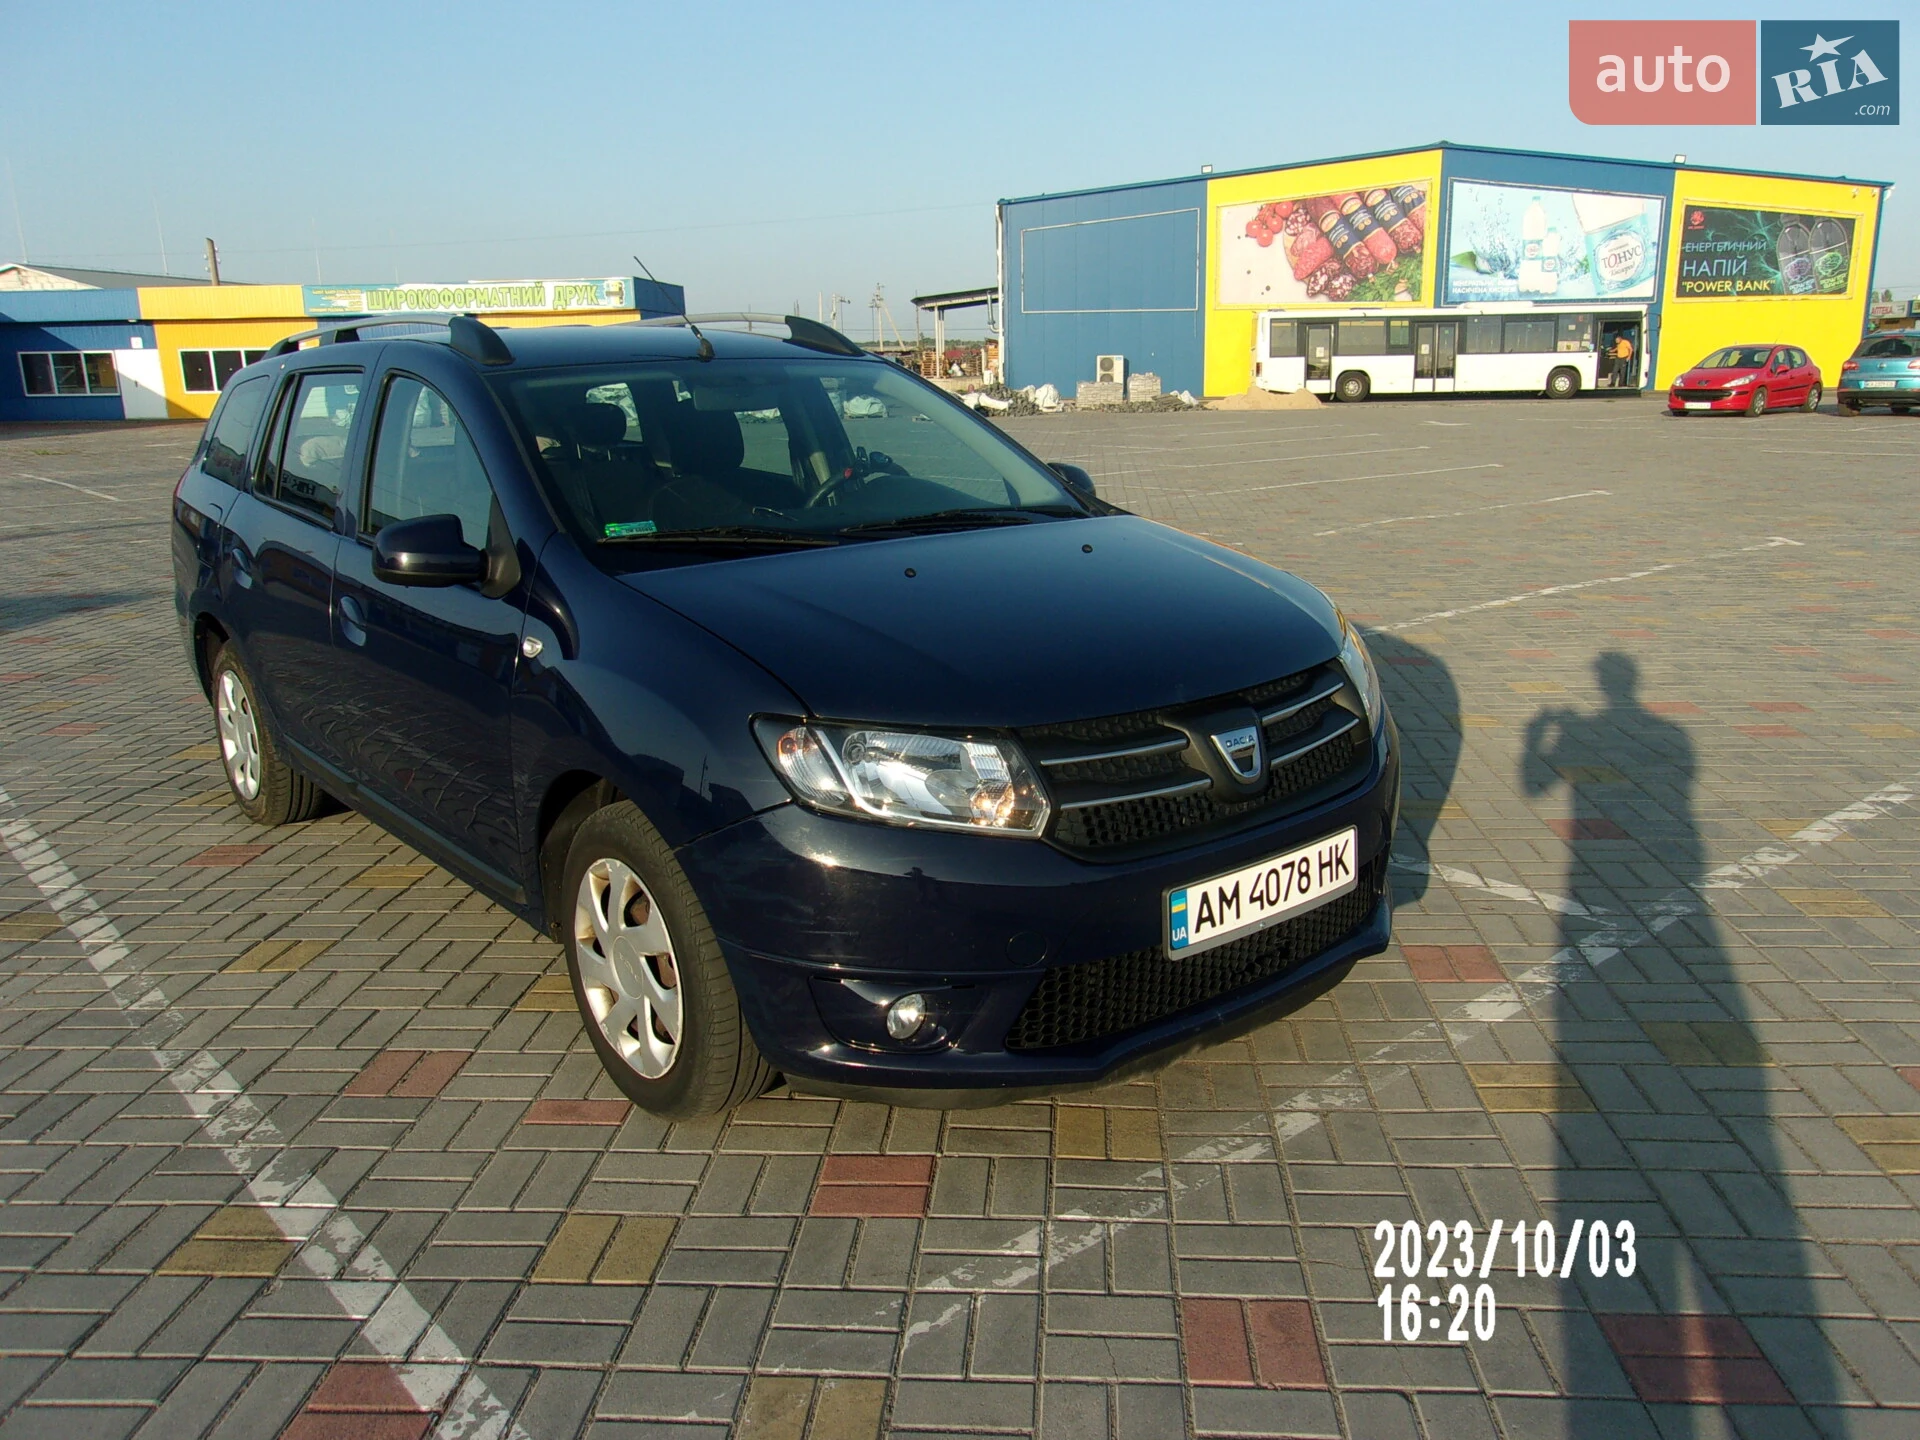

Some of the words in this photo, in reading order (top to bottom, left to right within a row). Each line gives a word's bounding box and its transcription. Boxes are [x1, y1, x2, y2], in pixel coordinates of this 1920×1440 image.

[1601, 245, 1642, 269] ТОНУС
[1685, 239, 1767, 253] ЕНЕРГЕТИЧНИЙ
[1682, 255, 1748, 277] НАПІЙ
[366, 281, 546, 311] ШИРОКОФОРМАТНИЙ
[552, 284, 600, 310] ДРУК
[1225, 734, 1256, 748] DACIA
[1195, 880, 1241, 934] AM
[1249, 856, 1311, 911] 4078
[1317, 838, 1350, 888] HK
[1172, 928, 1187, 941] UA
